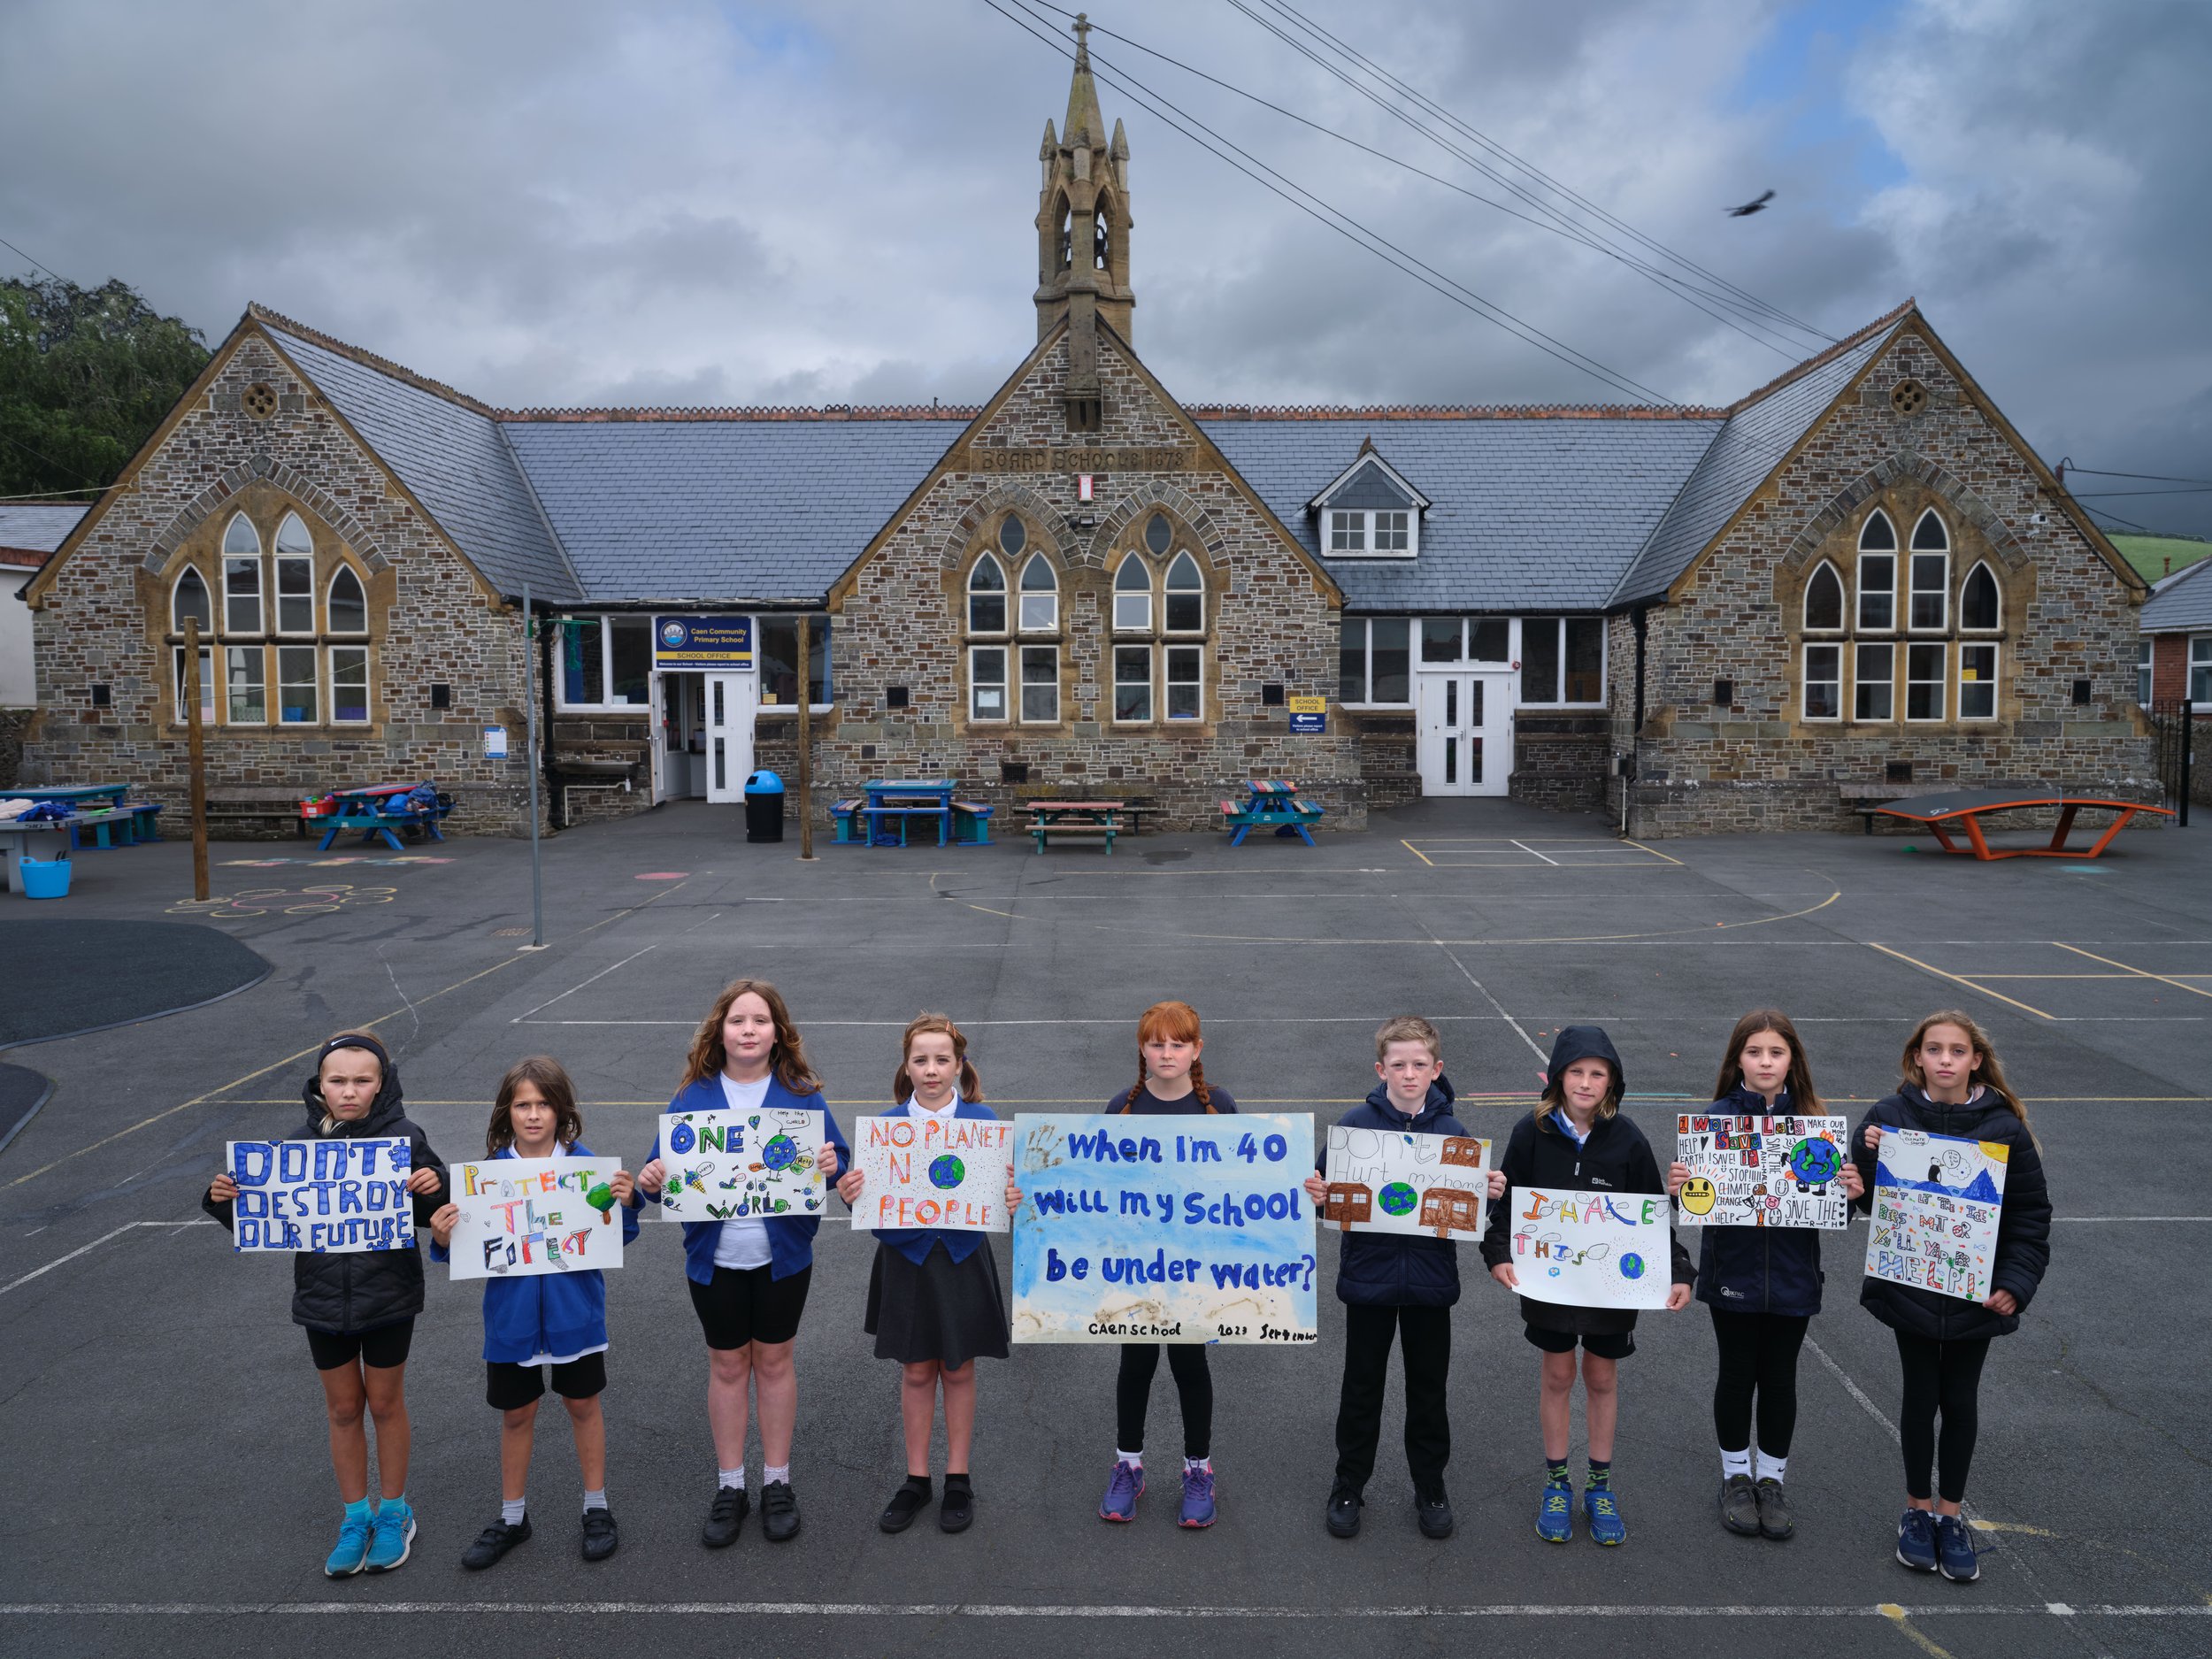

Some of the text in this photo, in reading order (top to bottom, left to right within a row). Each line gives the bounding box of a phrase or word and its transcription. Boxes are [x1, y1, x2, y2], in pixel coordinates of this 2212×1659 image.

[982, 450, 1045, 469] BOARD
[1052, 450, 1139, 470] SCHOOLS
[709, 628, 747, 637] Community
[671, 1123, 745, 1154] ONE
[870, 1119, 1012, 1149] NO PLANET
[1807, 1119, 1844, 1129] MAKE OUR
[1176, 1135, 1221, 1163] I'm
[1236, 1133, 1287, 1164] 40
[1679, 1139, 1698, 1155] HELP
[1766, 1138, 1781, 1174] SAVE THE
[1334, 1155, 1483, 1193] Hurt my home
[1719, 1182, 1751, 1195] CLIMATE
[237, 1179, 407, 1219] DESTROY
[706, 1196, 788, 1219] WORLD
[880, 1194, 991, 1229] PEOPLE
[1120, 1190, 1173, 1224] my
[1523, 1190, 1549, 1220] I
[1716, 1197, 1742, 1207] CHANGE
[1785, 1199, 1838, 1220] SAVE THE
[1966, 1205, 1987, 1223] ICE
[239, 1211, 411, 1249] OUR FUTURE
[1715, 1212, 1734, 1224] HELP
[1953, 1221, 1972, 1238] OR
[1513, 1233, 1588, 1266] THIS
[1046, 1248, 1315, 1292] be under water?
[1878, 1251, 1975, 1300] HELP!
[1218, 1324, 1247, 1336] 2023
